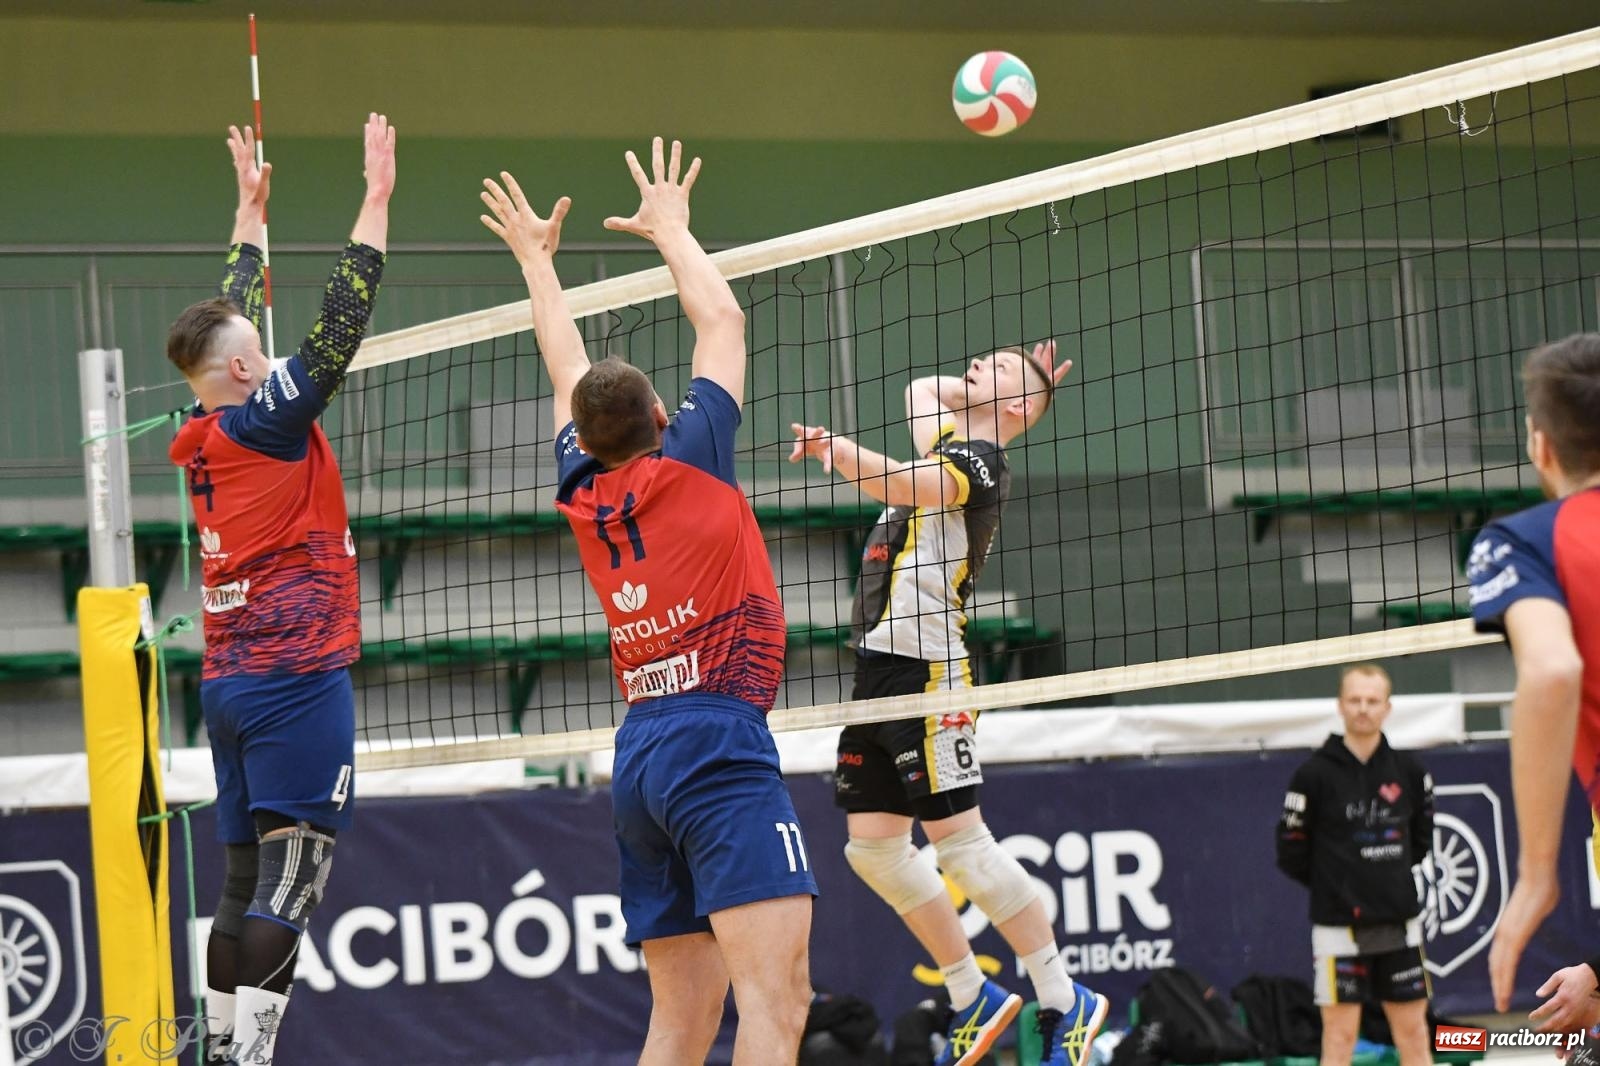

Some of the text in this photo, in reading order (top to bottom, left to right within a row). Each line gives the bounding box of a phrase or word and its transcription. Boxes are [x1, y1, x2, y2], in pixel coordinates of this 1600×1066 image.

[595, 492, 646, 569] 11
[610, 597, 699, 645] ATOLIK
[955, 738, 973, 769] 6
[331, 765, 352, 811] 4
[775, 822, 808, 872] 11
[187, 868, 648, 998] ACIBÓR
[1015, 933, 1176, 978] CIBÓRZ
